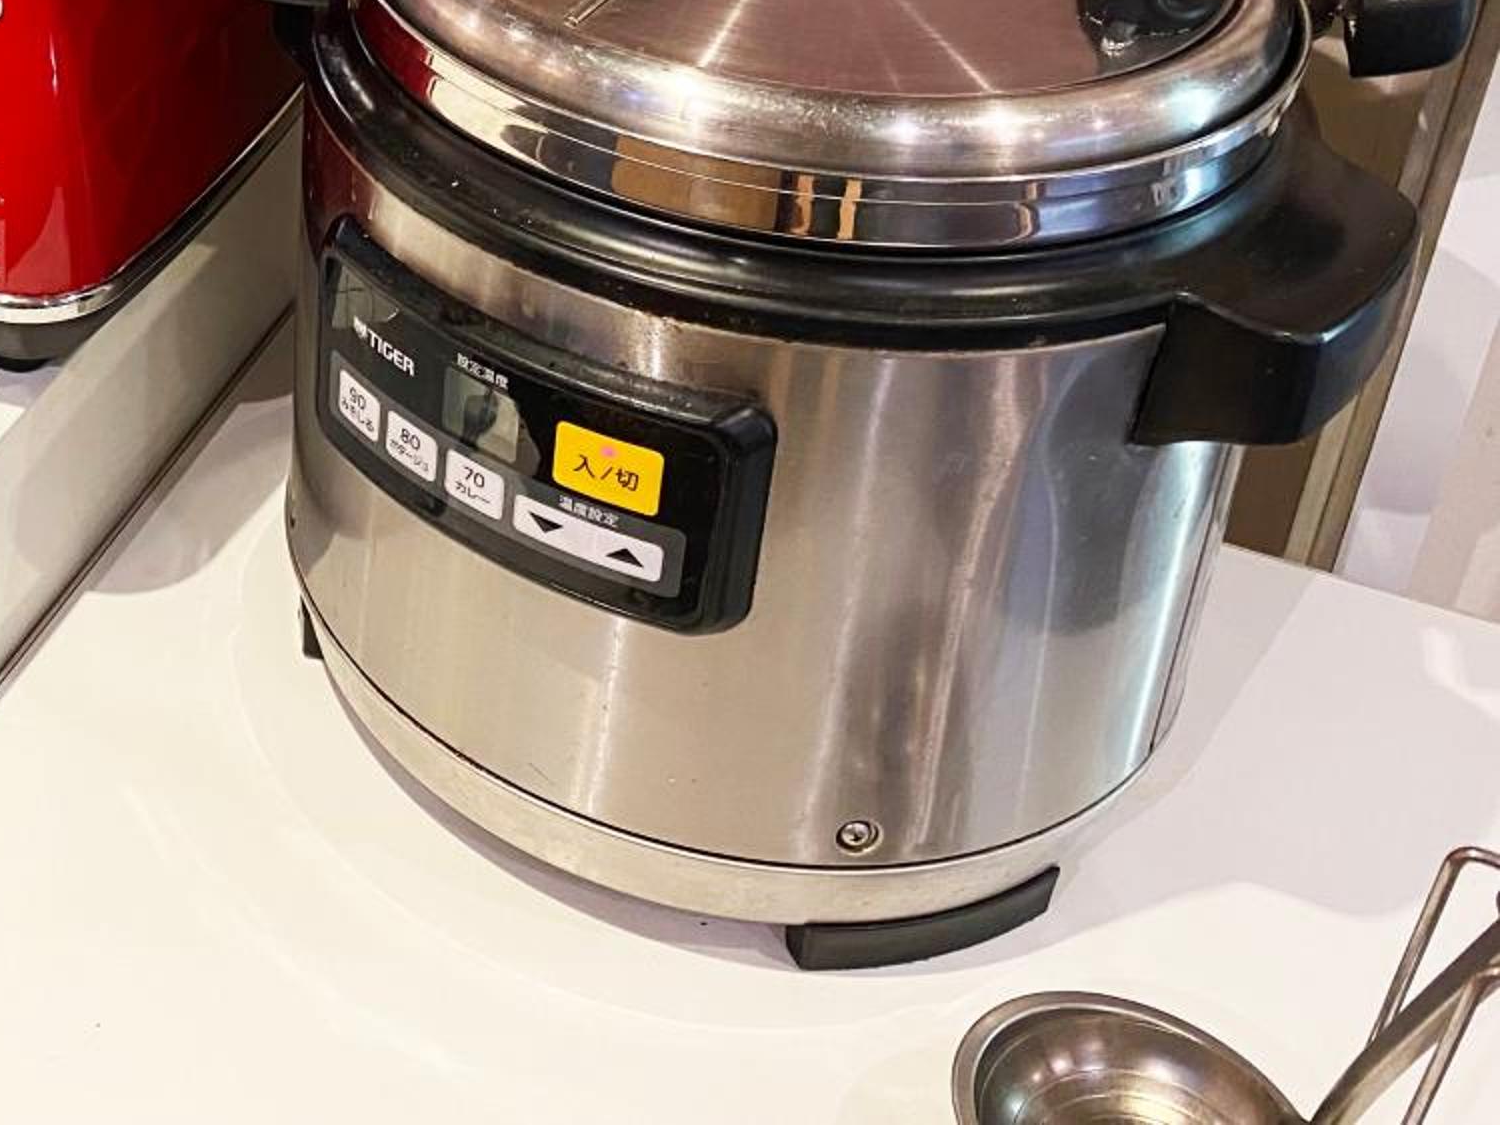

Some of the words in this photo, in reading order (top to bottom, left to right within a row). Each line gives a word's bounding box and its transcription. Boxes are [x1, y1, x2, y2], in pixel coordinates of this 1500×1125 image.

[368, 328, 415, 377] TIGER
[349, 386, 367, 411] 90
[400, 427, 421, 451] 80
[464, 466, 485, 488] 70
[455, 480, 491, 504] カレー
